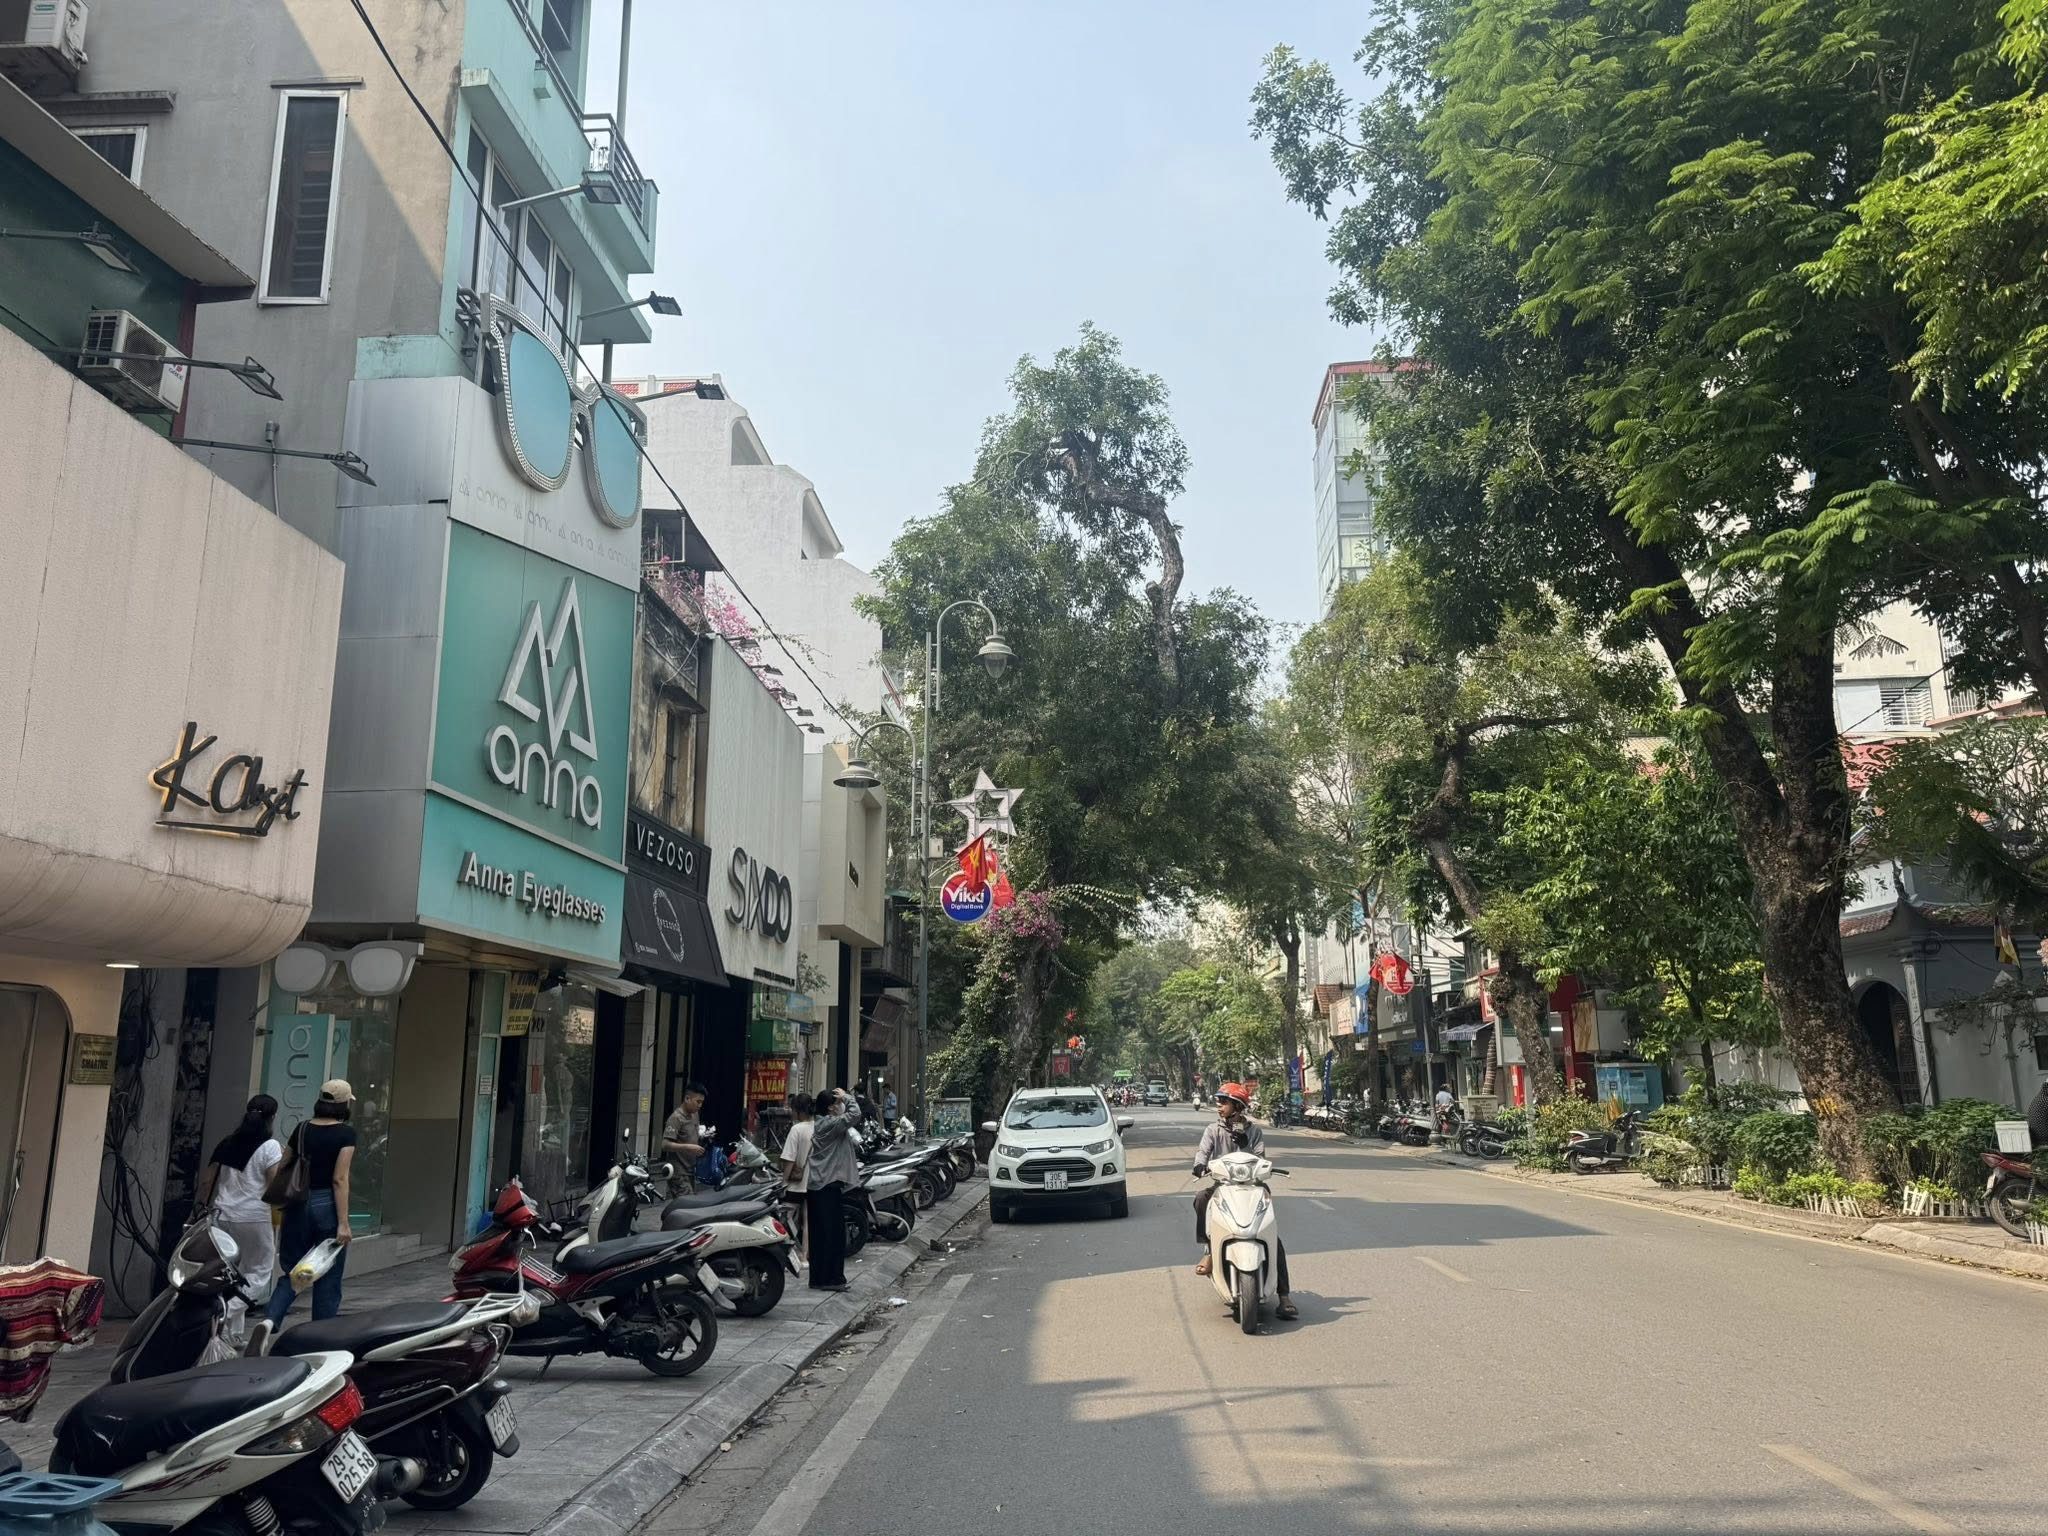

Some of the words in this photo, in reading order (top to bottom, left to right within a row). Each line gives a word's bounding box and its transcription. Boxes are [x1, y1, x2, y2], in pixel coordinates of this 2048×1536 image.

[485, 724, 602, 830] anna
[636, 823, 694, 875] VEZOSO
[462, 851, 515, 897] Anna
[519, 870, 606, 924] Eyeglasses
[725, 846, 793, 944] SIXDO
[950, 903, 970, 911] Digital
[328, 1437, 360, 1479] 29-C1
[338, 1451, 375, 1498] 025.68
